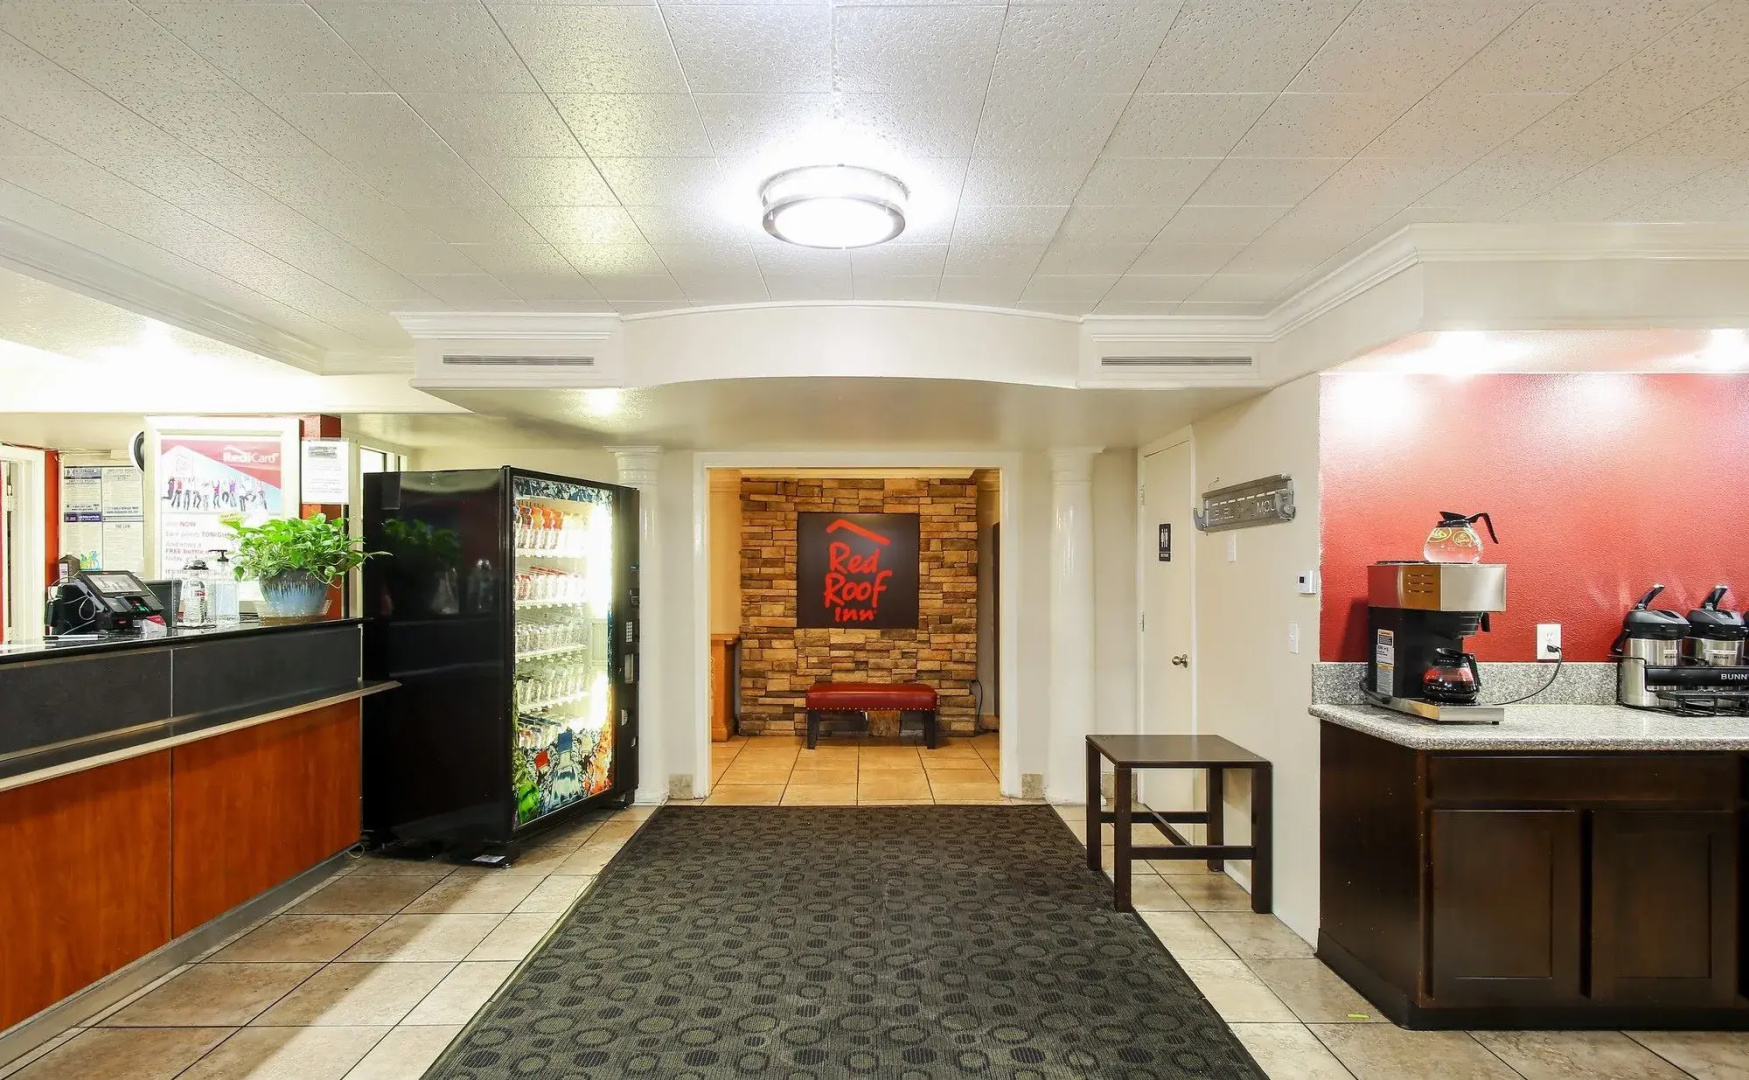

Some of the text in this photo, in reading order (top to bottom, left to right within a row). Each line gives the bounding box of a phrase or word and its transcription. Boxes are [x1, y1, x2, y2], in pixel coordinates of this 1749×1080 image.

[829, 541, 881, 574] Red
[823, 570, 893, 608] Roof
[1720, 673, 1748, 681] BUNN
